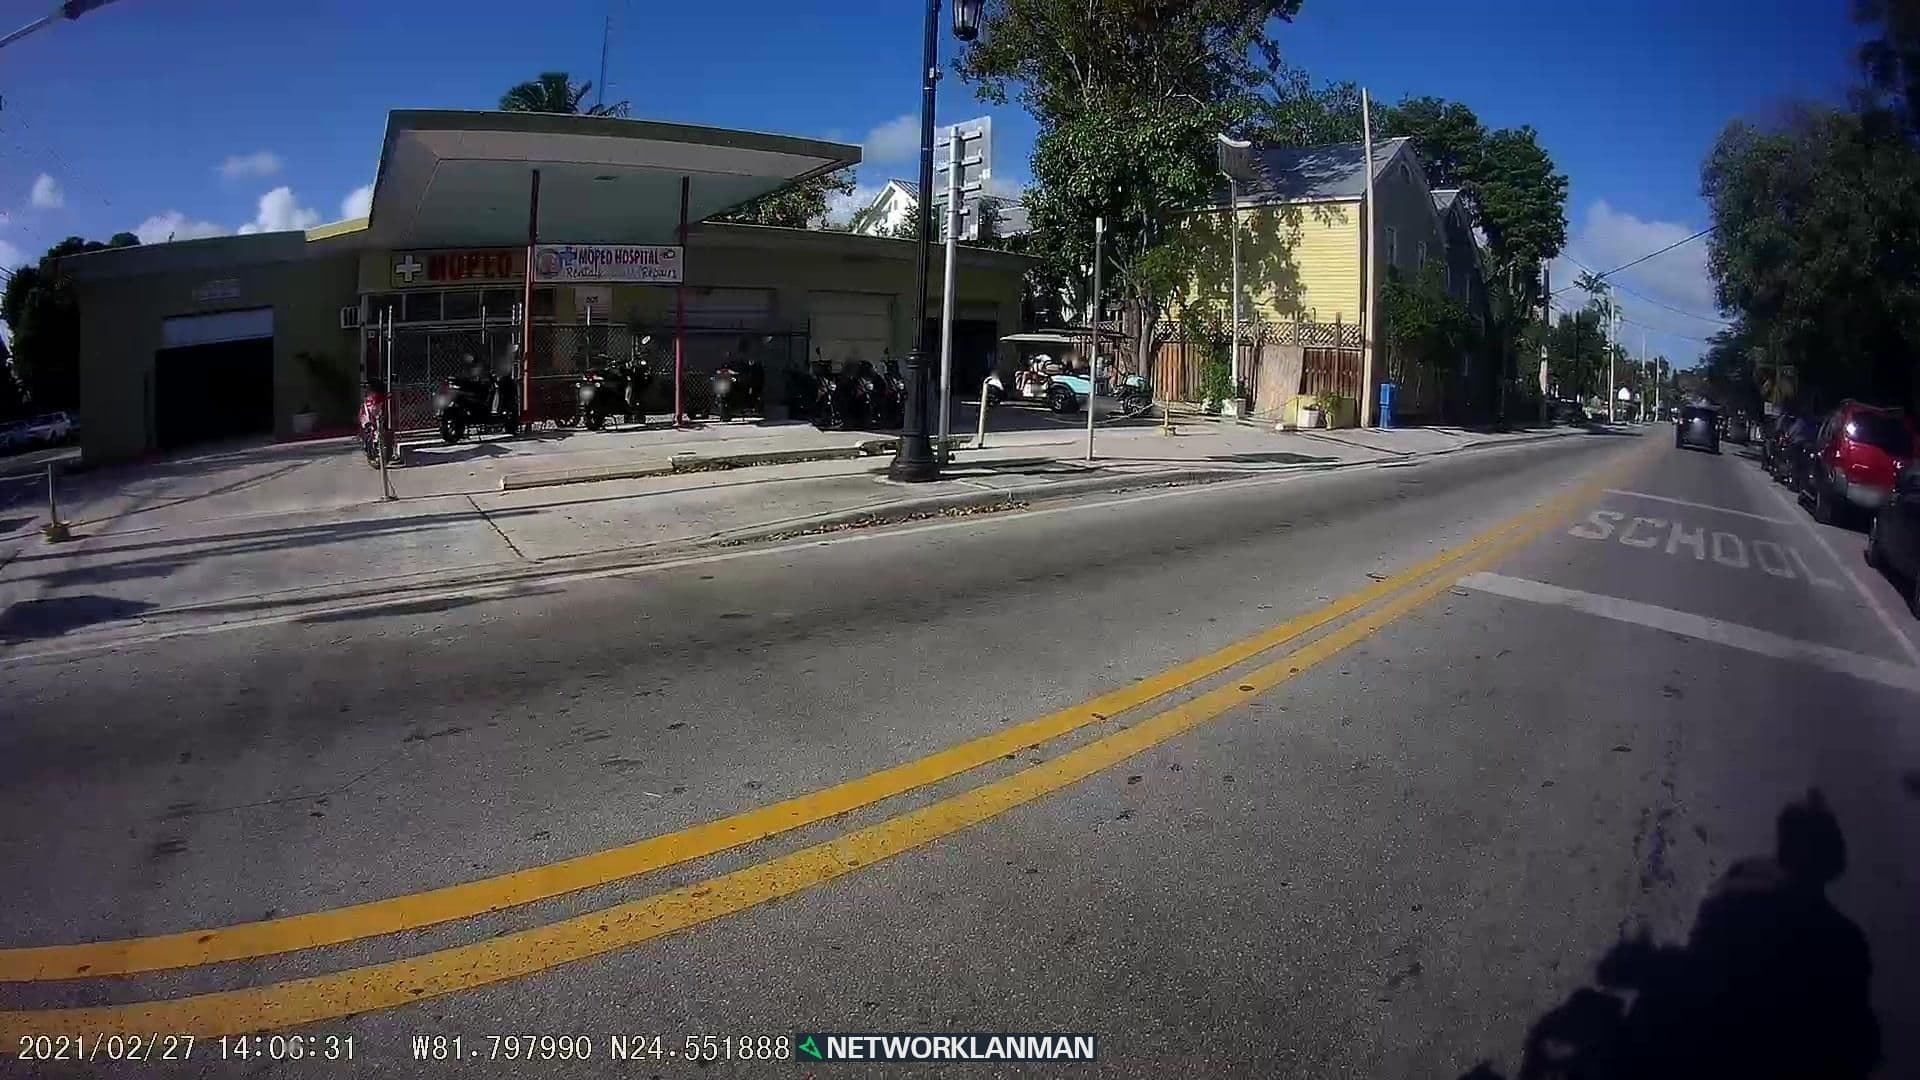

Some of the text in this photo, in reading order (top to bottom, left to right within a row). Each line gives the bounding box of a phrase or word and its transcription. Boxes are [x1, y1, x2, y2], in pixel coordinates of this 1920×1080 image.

[427, 252, 513, 281] MOPED
[578, 247, 660, 265] MOPED HOSPITAL
[1568, 510, 1845, 591] SCHOOL
